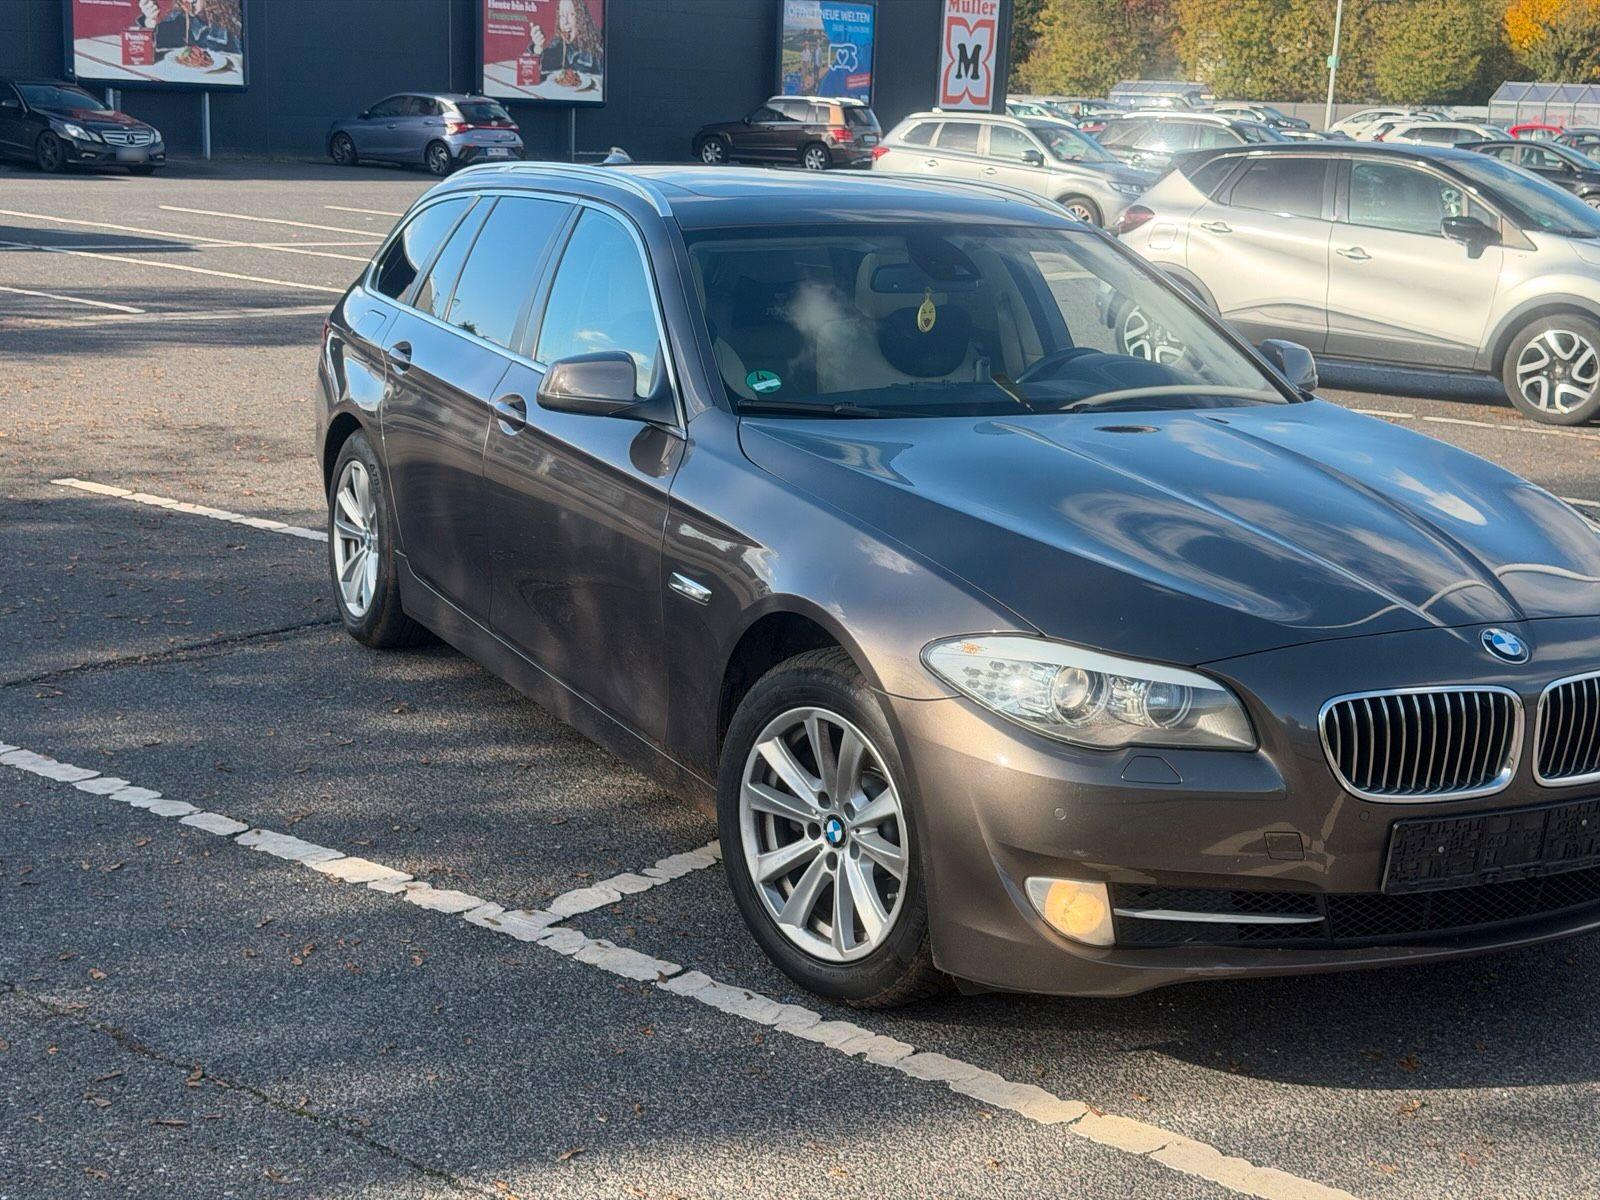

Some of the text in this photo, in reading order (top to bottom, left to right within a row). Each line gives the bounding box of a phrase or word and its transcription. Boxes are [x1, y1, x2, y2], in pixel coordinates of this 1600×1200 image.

[525, 1, 537, 13] ich
[841, 10, 870, 23] WELTEN
[955, 43, 982, 80] M
